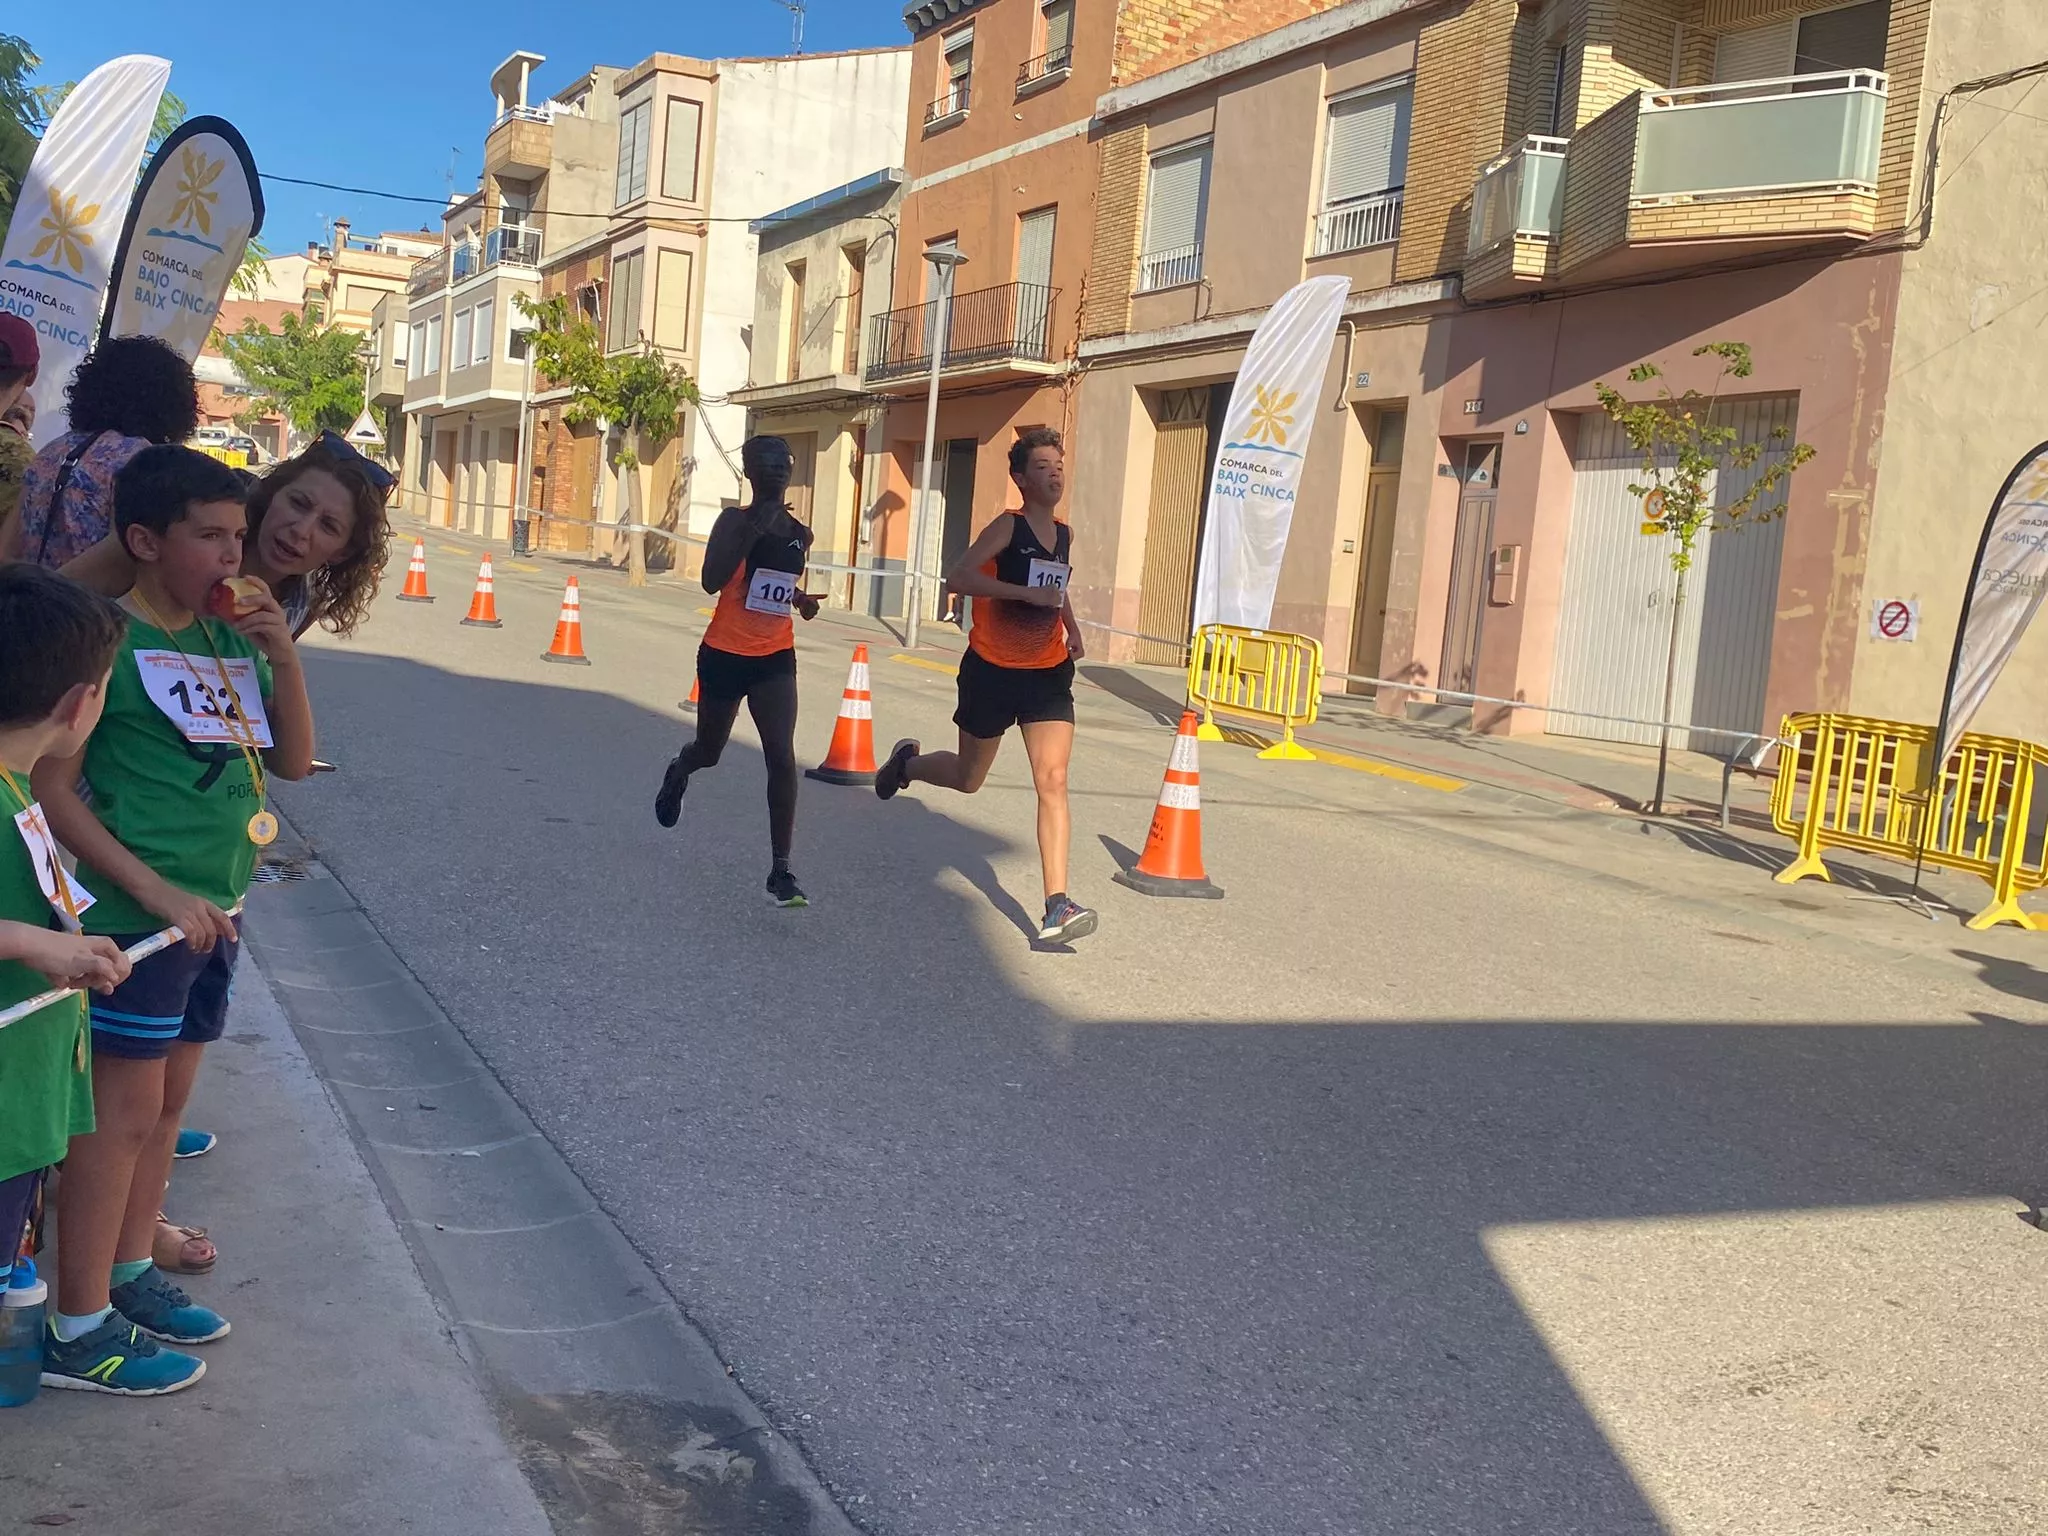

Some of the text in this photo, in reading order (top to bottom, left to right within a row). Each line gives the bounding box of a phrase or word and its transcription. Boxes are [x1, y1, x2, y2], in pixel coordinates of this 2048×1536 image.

[138, 265, 169, 288] BAJO
[142, 250, 203, 281] COMARCA DEL
[0, 279, 76, 316] COMARCA DEL
[135, 286, 166, 310] BAIX
[170, 289, 215, 316] CINCA
[36, 319, 89, 350] CINCA
[1357, 374, 1369, 386] 22
[1217, 468, 1249, 485] BAJO
[1220, 457, 1284, 478] COMARCA DEL
[1214, 483, 1247, 500] BAIX
[1250, 483, 1295, 502] CINCA
[1037, 571, 1063, 589] 105
[168, 680, 241, 720] 132
